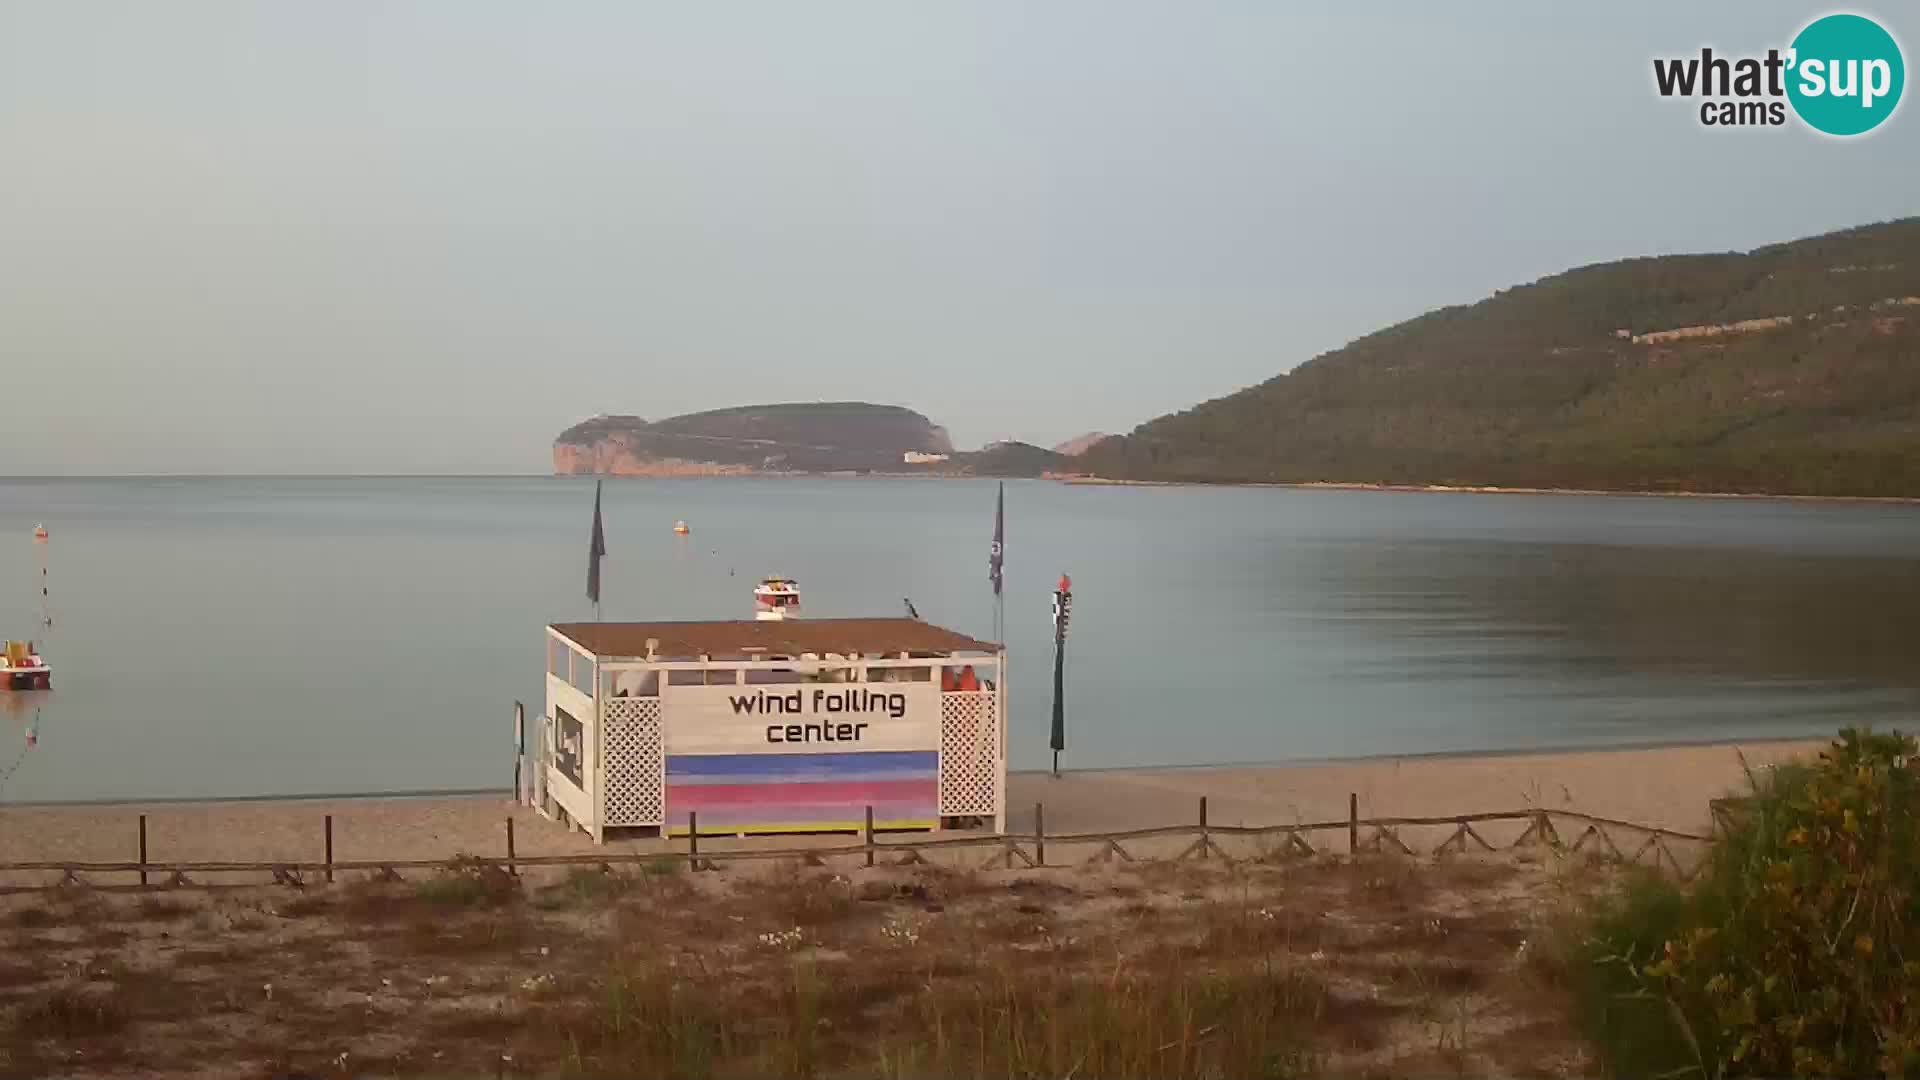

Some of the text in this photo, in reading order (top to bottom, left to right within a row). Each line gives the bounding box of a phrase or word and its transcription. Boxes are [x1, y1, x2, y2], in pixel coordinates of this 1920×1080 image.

[729, 687, 906, 718] wind foiling
[766, 719, 869, 743] center
